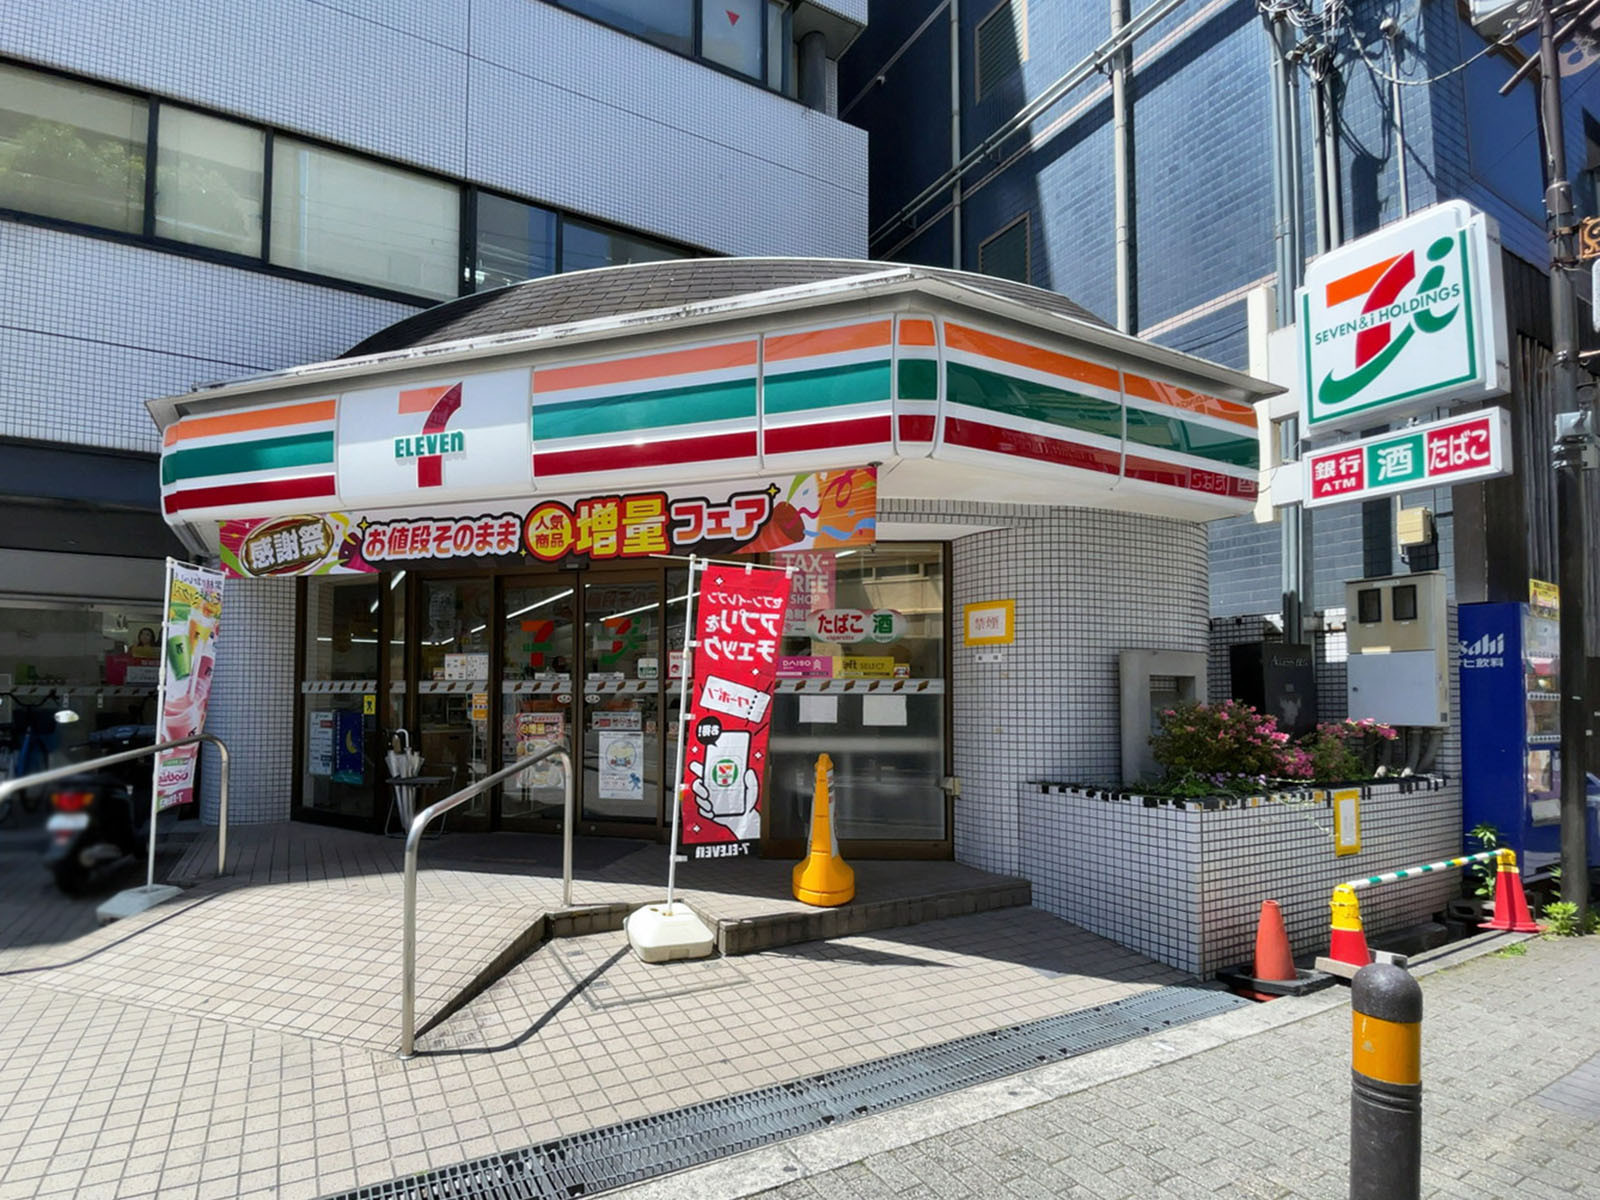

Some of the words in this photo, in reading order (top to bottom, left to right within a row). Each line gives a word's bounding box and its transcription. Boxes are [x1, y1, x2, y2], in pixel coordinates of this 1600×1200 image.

[1379, 283, 1461, 321] HOLDINGS
[1314, 455, 1363, 480] 銀行
[1377, 443, 1413, 481] 酒
[1429, 429, 1490, 471] たばこ
[1321, 477, 1357, 493] ATM
[535, 514, 565, 531] 人気
[250, 522, 326, 570] 感謝祭
[364, 517, 518, 558] お値段そのまま
[535, 532, 565, 549] 商品
[791, 574, 830, 593] REE
[790, 594, 820, 605] SHOP
[817, 613, 864, 634] たばこ
[872, 614, 893, 634] 酒
[1459, 632, 1505, 656] sahi
[1460, 657, 1504, 668] ヒ飲料
